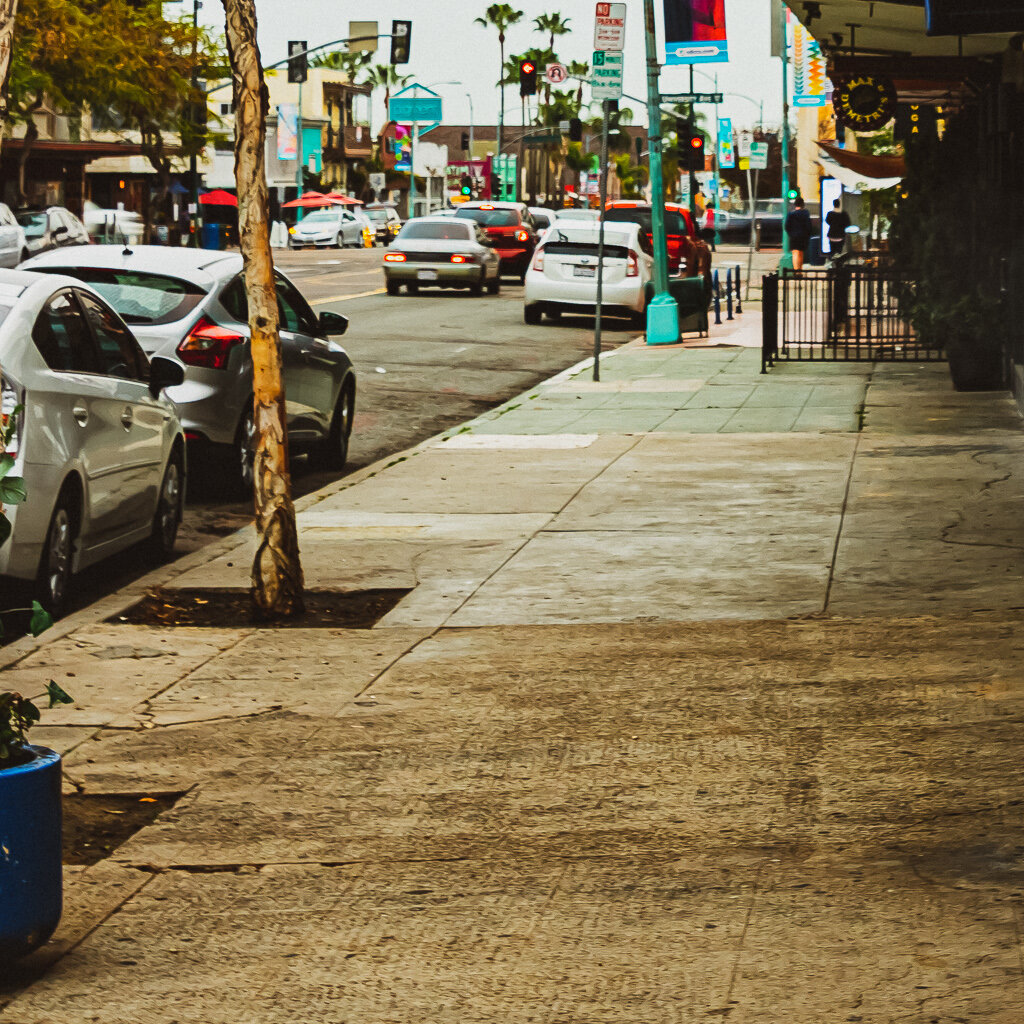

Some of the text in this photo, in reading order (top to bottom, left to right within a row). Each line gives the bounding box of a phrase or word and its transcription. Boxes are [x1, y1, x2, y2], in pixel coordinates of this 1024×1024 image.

[597, 4, 609, 16] NO
[597, 18, 624, 27] PARKING
[593, 51, 605, 65] 15
[595, 69, 621, 78] PARKING
